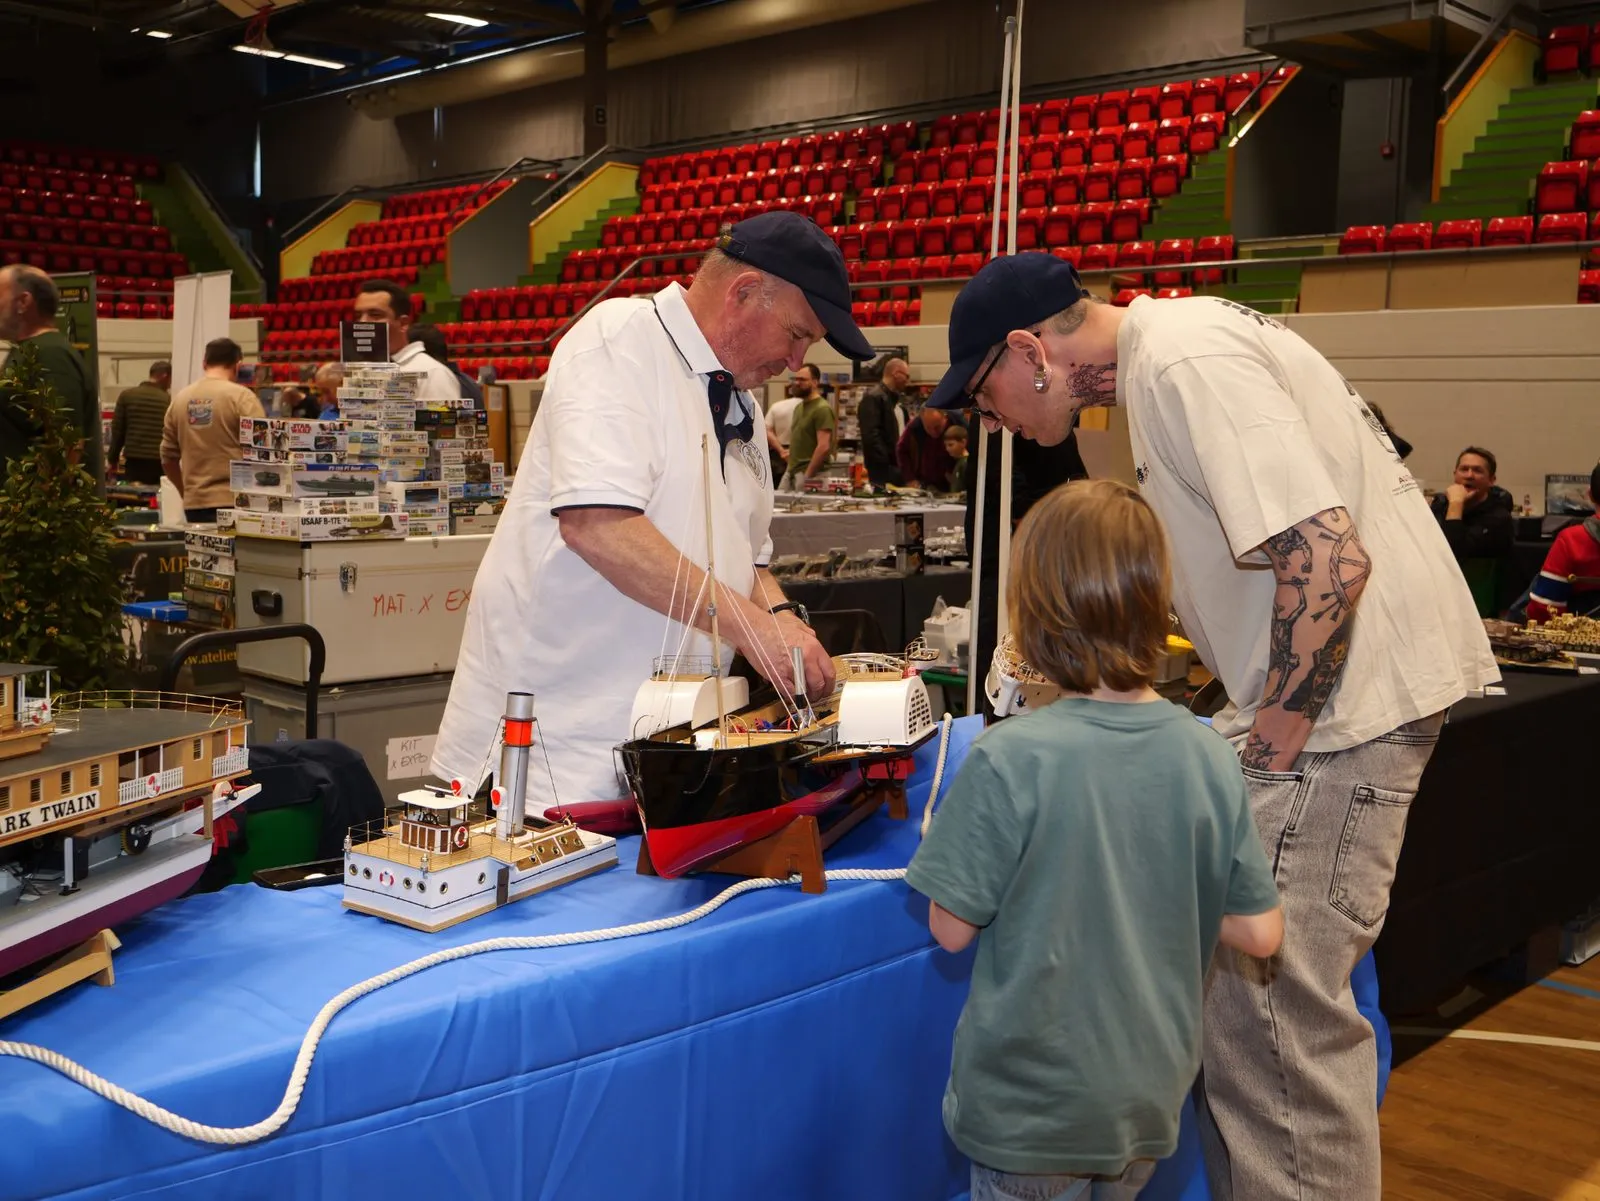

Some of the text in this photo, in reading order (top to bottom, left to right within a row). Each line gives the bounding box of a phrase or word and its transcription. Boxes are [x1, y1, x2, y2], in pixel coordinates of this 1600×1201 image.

[596, 108, 606, 125] B
[301, 516, 322, 526] USAAF
[323, 516, 341, 525] B-17E
[400, 738, 422, 752] KIT
[0, 793, 97, 834] RK TWAIN
